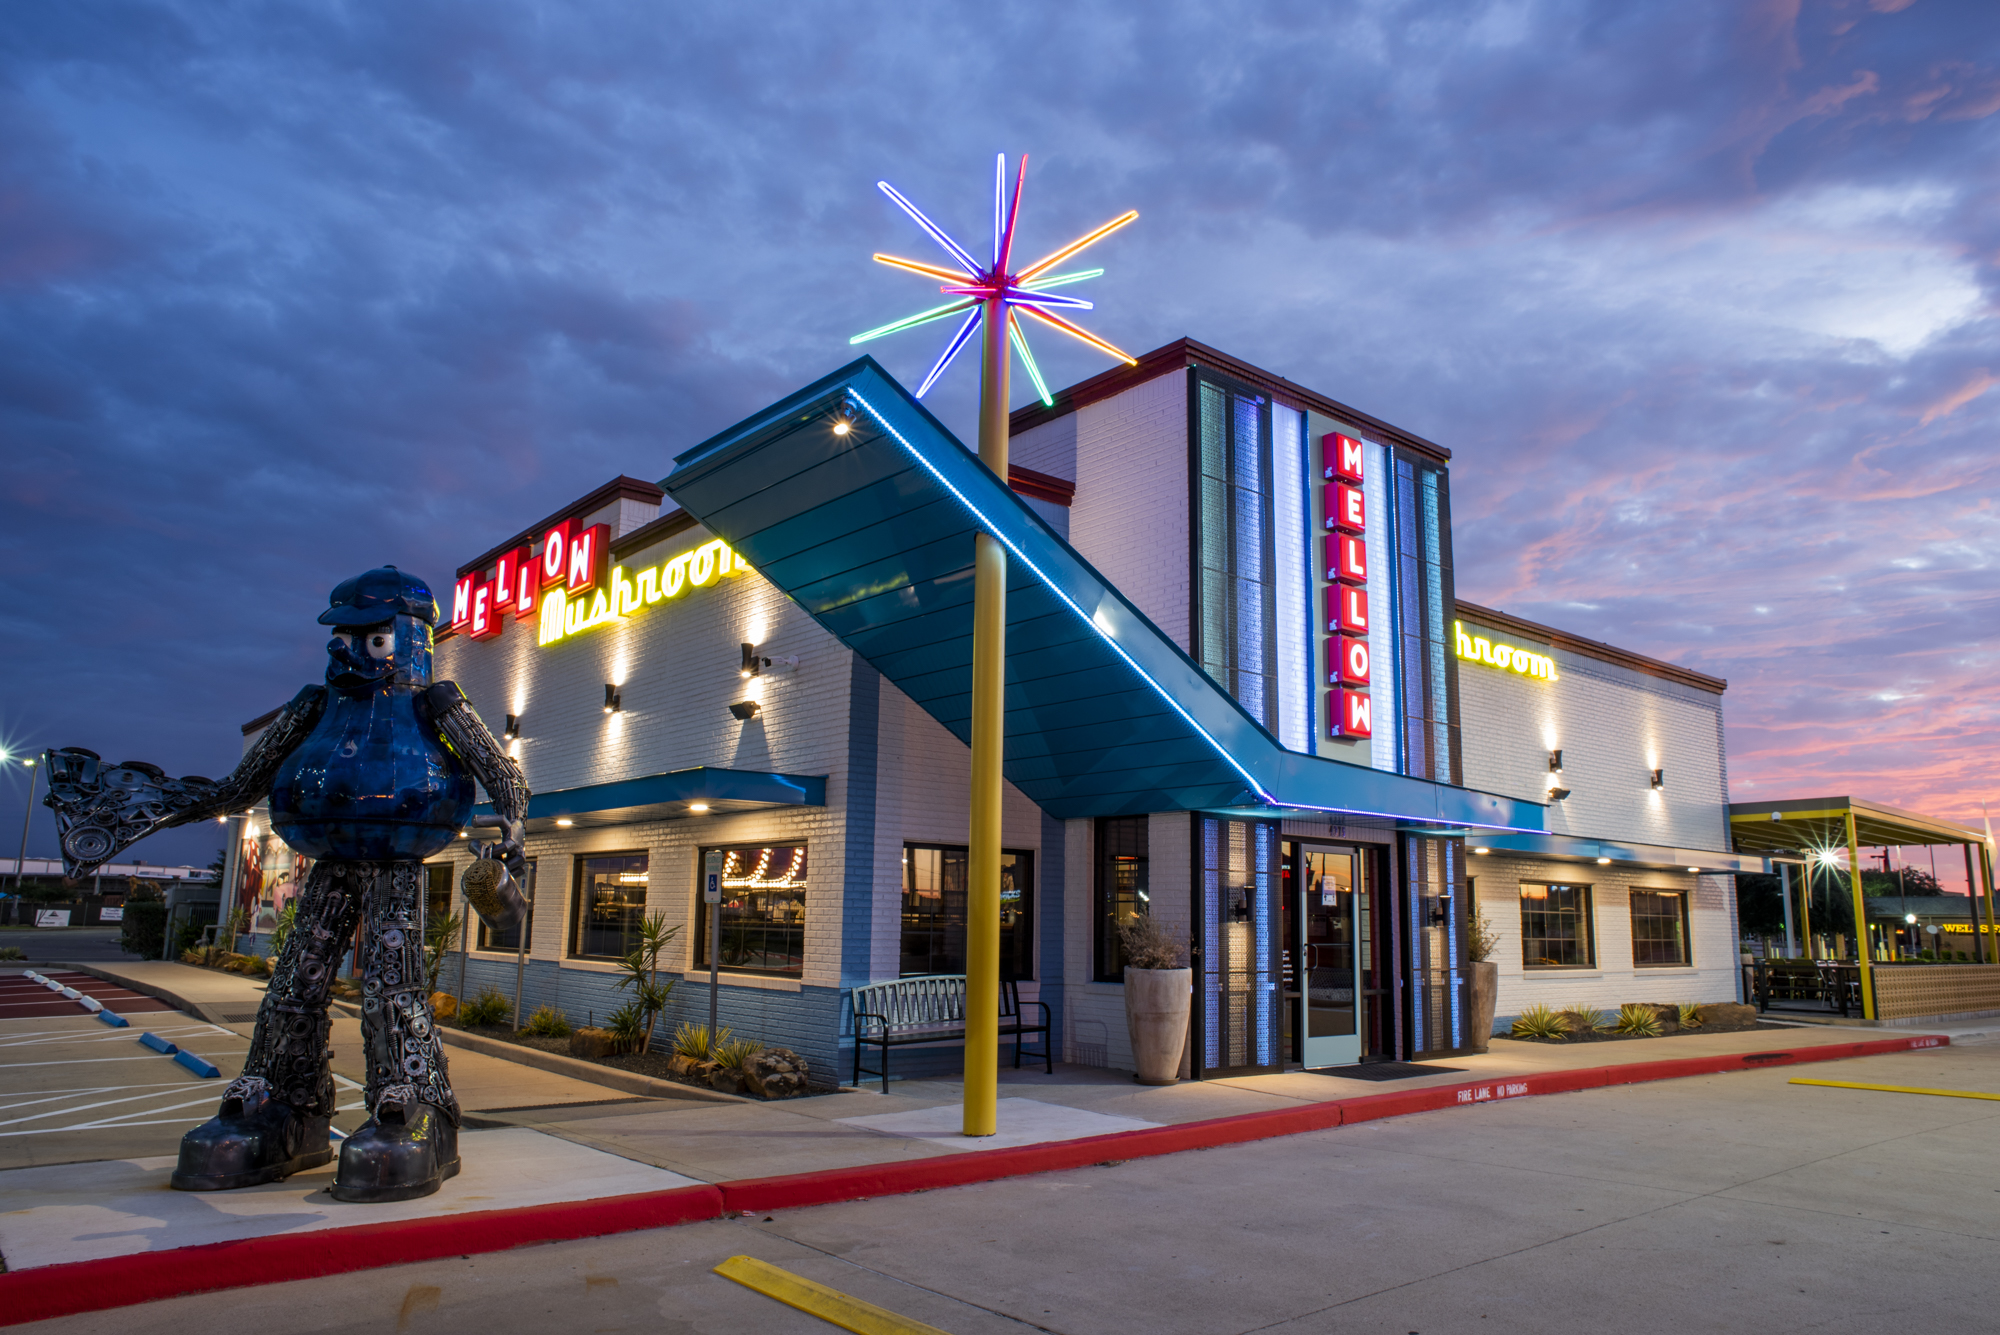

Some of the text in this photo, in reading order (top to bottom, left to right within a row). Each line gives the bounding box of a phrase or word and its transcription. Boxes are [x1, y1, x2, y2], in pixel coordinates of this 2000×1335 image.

[453, 531, 590, 632] MELLOW
[1343, 438, 1371, 731] MELLOW
[1942, 923, 1989, 934] WELS
[1458, 1082, 1527, 1102] FIRE LANE NO PARKING
